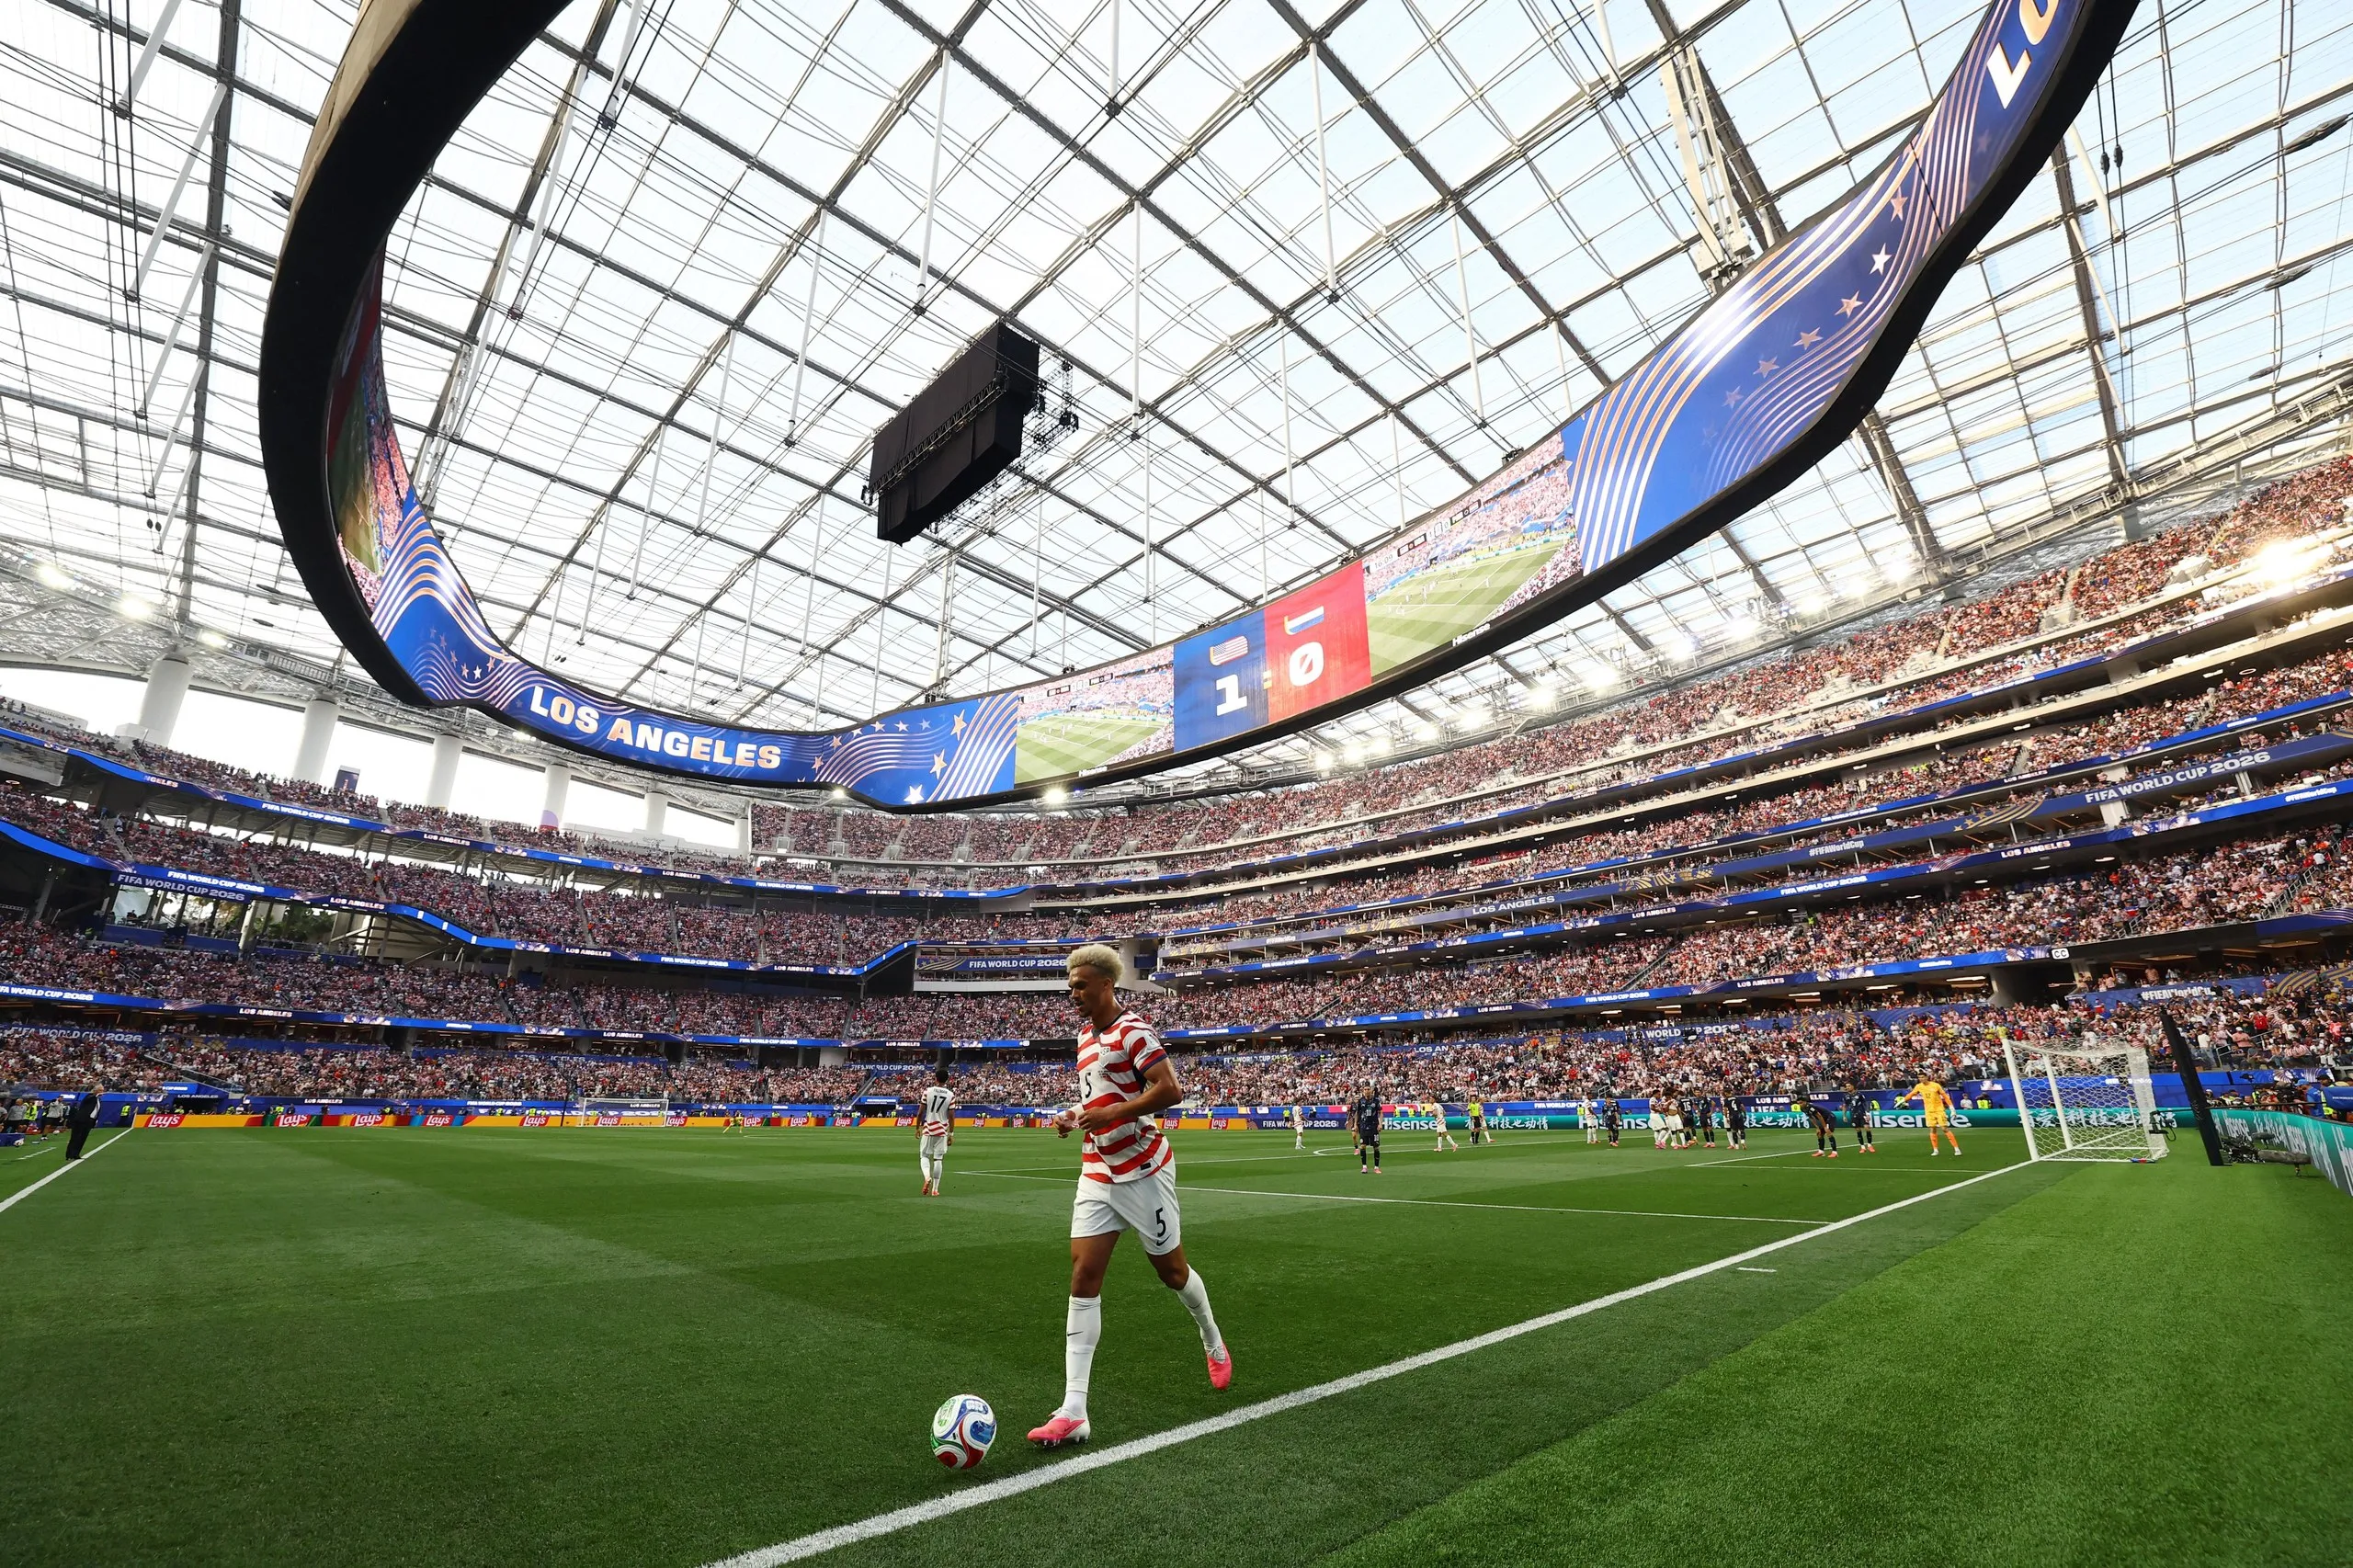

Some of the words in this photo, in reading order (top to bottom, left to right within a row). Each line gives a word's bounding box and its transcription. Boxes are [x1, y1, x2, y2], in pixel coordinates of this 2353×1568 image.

[1986, 0, 2060, 109] LO
[1452, 623, 1491, 647] Hisense
[1216, 674, 1248, 716] 1
[1289, 642, 1324, 687] 0
[530, 685, 600, 734] LOS
[607, 717, 781, 769] ANGELES
[2085, 789, 2119, 803] FIFA
[2119, 775, 2175, 796] WORLD
[2175, 767, 2208, 782] CUP
[2210, 751, 2271, 774] 2026
[1809, 839, 1864, 857] #FIFAWorldCup
[2001, 848, 2021, 858] LOS
[2023, 840, 2071, 855] ANGELES
[167, 870, 187, 880] FIFA
[188, 875, 219, 885] WORLD
[219, 880, 236, 888] CUP
[118, 874, 143, 885] FIFA
[145, 879, 186, 892] WORLD
[187, 885, 208, 894] CUP
[209, 889, 245, 902] 2026
[1780, 887, 1797, 895] FIFA
[1797, 883, 1824, 893] WORLD
[347, 899, 385, 910] ANGELES
[1472, 905, 1496, 915] LOS
[1498, 895, 1555, 911] ANGELES
[1646, 907, 1677, 916] ANGELES
[2053, 949, 2067, 958] CC
[1037, 959, 1067, 967] 2026
[1752, 977, 1784, 986] ANGELES
[10, 986, 44, 997] WORLD
[44, 990, 63, 998] CUP
[256, 1009, 293, 1017] ANGELES
[106, 1033, 143, 1043] 2026
[1645, 1028, 1681, 1039] WORLD
[1085, 1072, 1092, 1098] 5
[931, 1095, 947, 1113] 17
[1683, 1101, 1691, 1111] 16
[1731, 1100, 1737, 1110] 4
[149, 1115, 181, 1127] Lay's
[278, 1114, 309, 1127] Lay's
[355, 1114, 382, 1127] Lay's
[426, 1115, 450, 1126] Lay's
[523, 1115, 547, 1127] Lay's
[597, 1116, 619, 1127] Lay's
[666, 1117, 686, 1127] Lay's
[744, 1117, 761, 1127] Lay's
[790, 1117, 808, 1127] Lay's
[835, 1118, 851, 1127] Lay's
[897, 1117, 913, 1127] Lay's
[1164, 1118, 1178, 1129] Lay's
[1211, 1118, 1227, 1130] Lay's
[1155, 1207, 1166, 1237] 5
